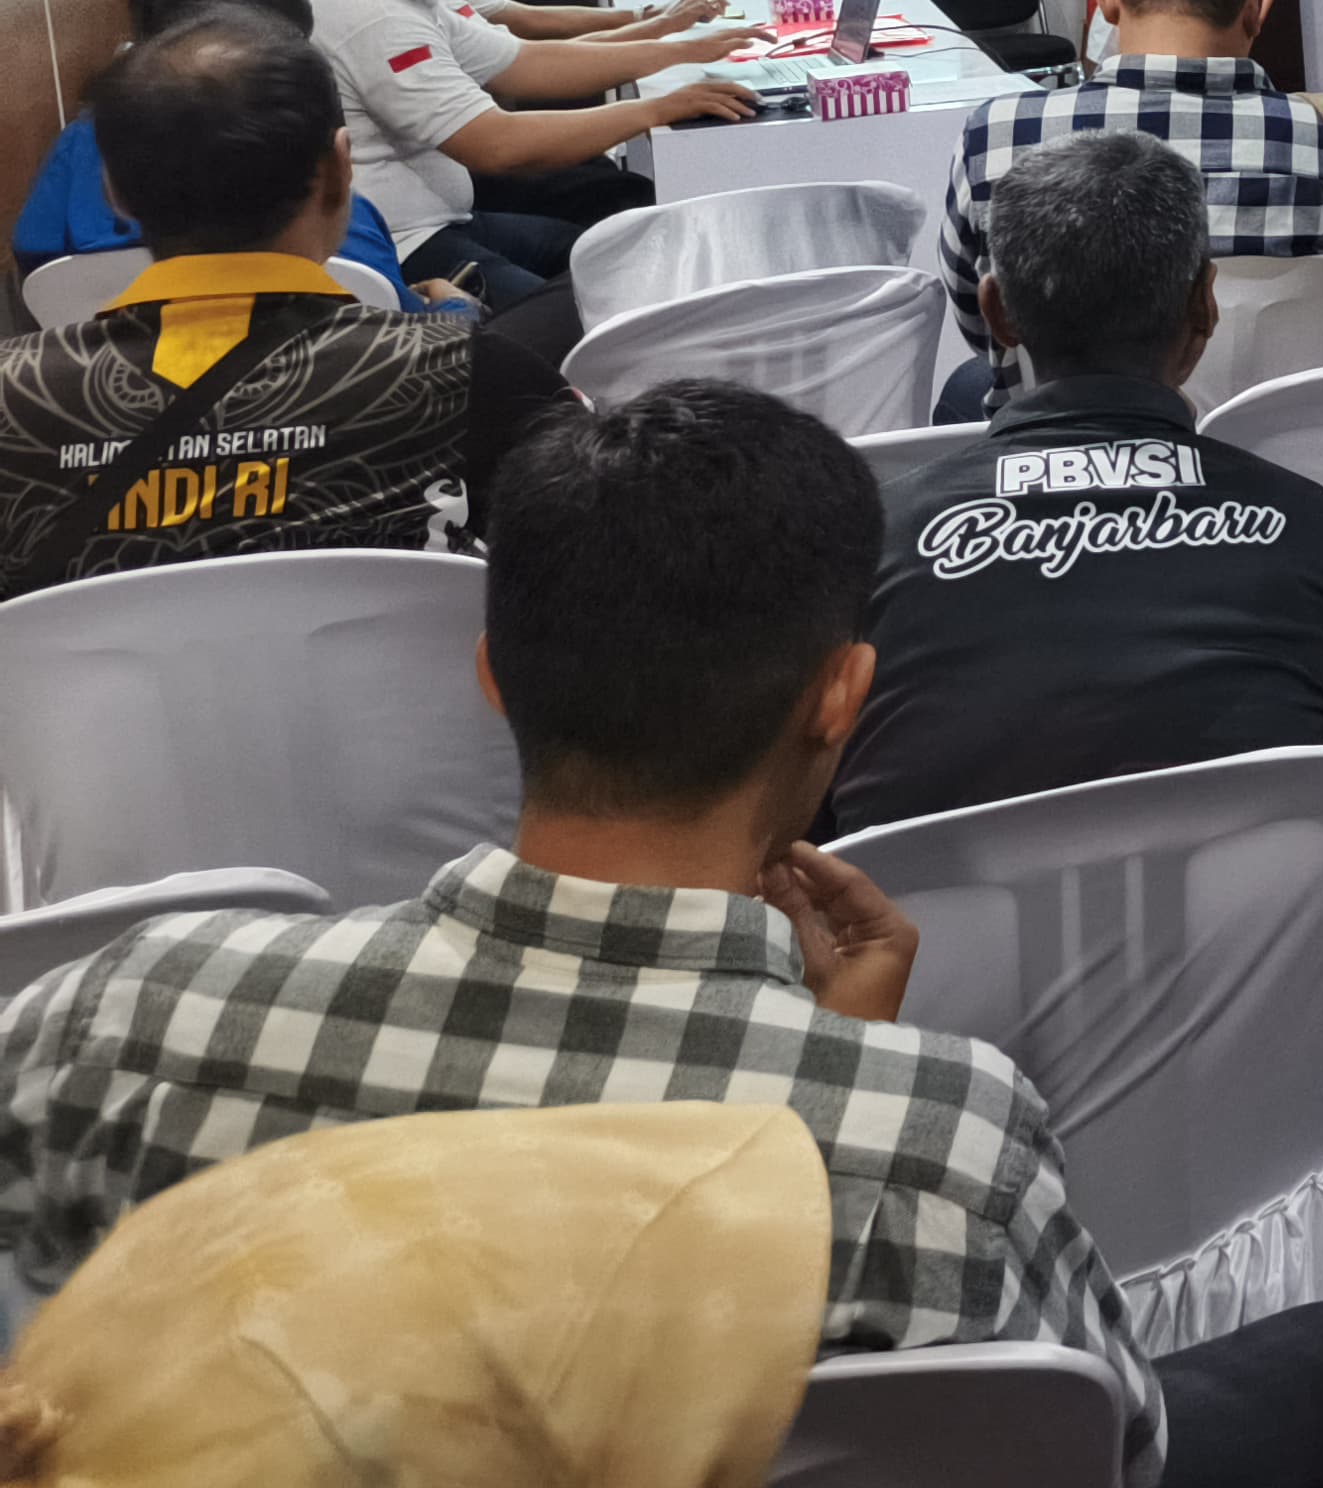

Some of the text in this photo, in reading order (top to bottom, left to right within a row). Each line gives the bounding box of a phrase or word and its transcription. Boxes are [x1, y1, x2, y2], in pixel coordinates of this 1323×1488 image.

[216, 425, 326, 456] SELATAN
[995, 439, 1207, 497] PBVSI
[918, 491, 1287, 580] Banjarbaru
